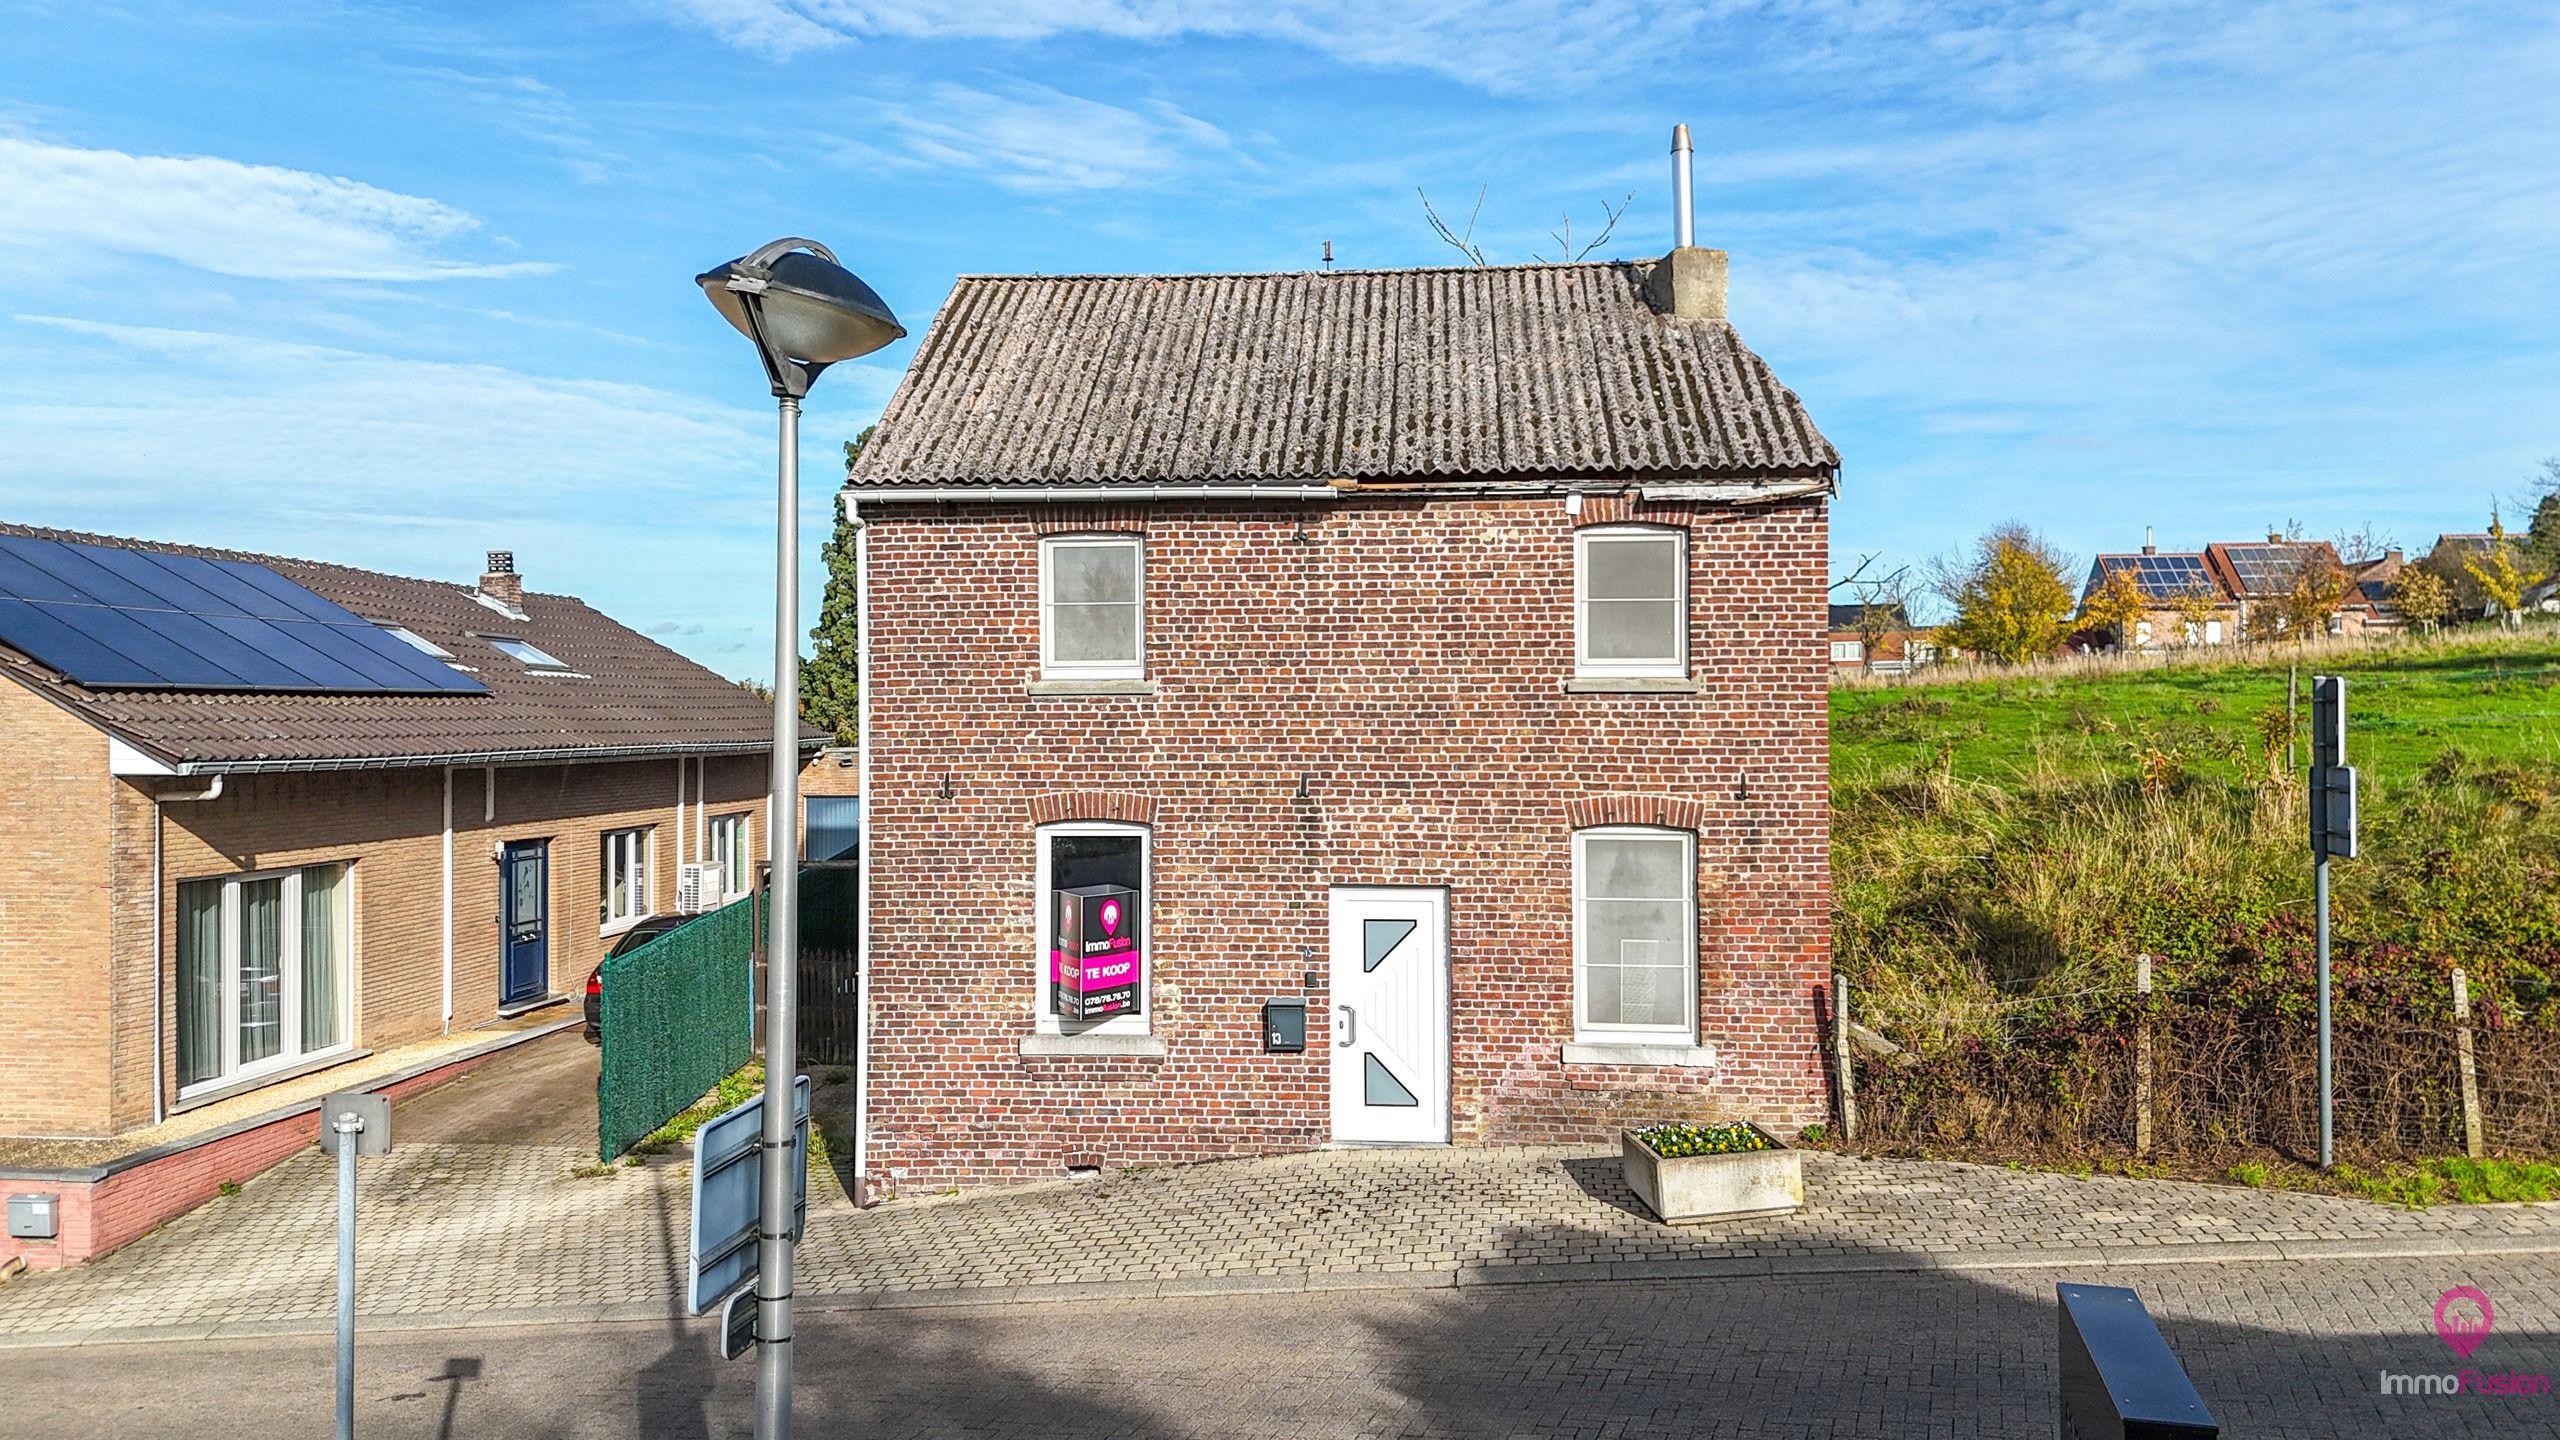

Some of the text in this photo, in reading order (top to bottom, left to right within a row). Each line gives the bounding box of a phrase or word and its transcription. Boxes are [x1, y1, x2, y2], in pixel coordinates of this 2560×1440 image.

[1064, 965, 1080, 979] KOOP
[1085, 962, 1131, 979] TE KOOP
[1084, 990, 1131, 1006] 078/78.78.70
[1271, 1032, 1282, 1045] 13
